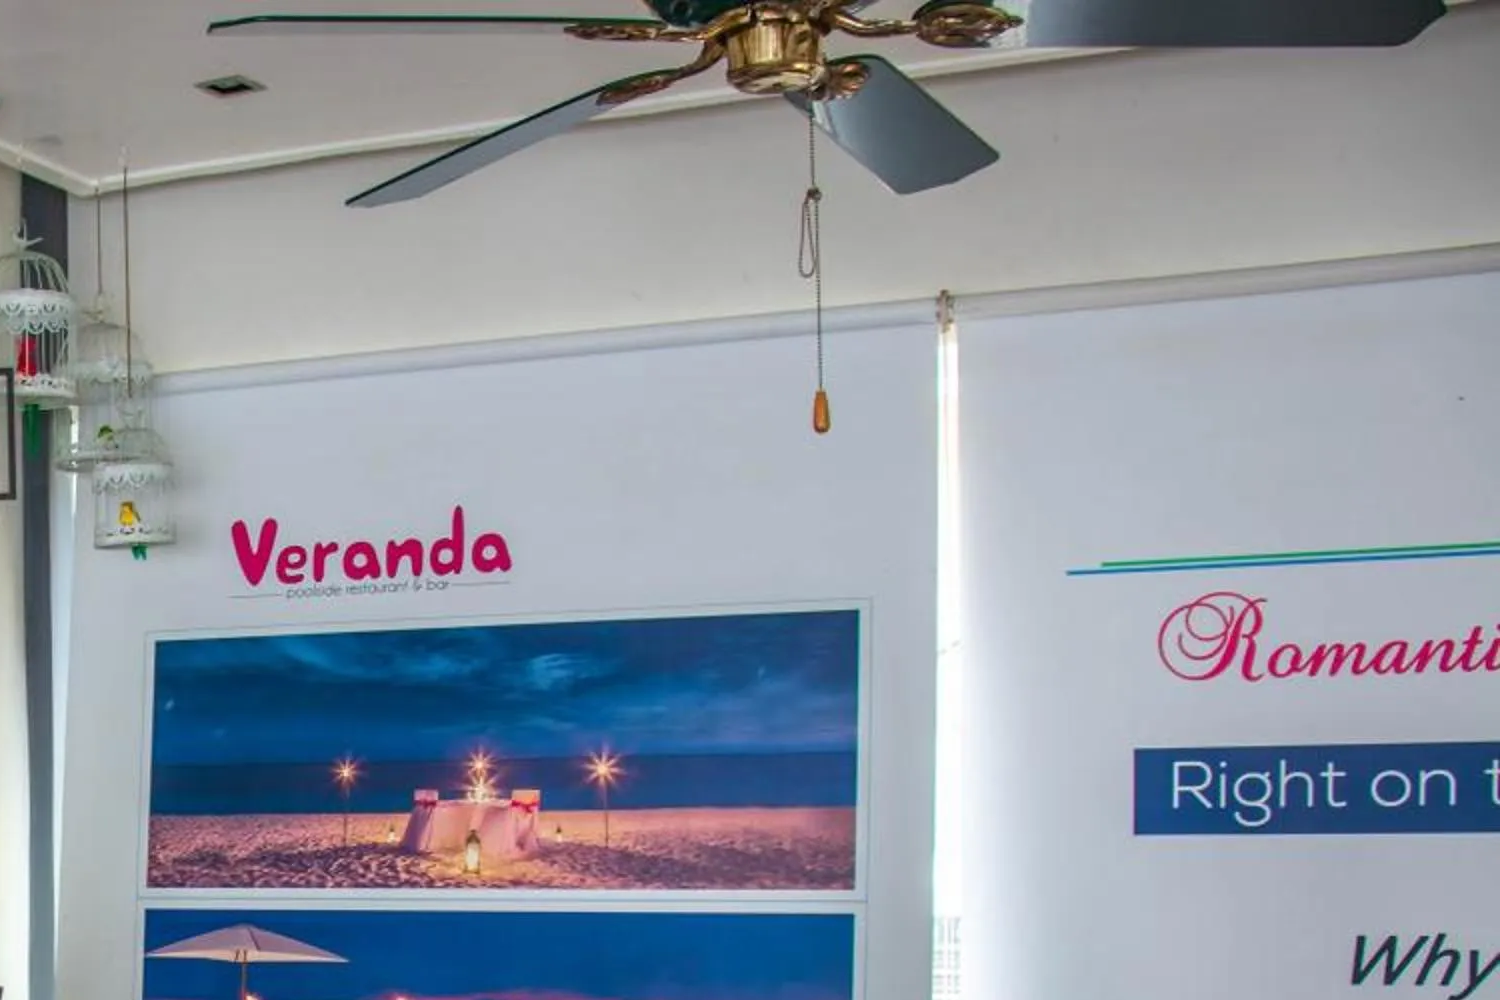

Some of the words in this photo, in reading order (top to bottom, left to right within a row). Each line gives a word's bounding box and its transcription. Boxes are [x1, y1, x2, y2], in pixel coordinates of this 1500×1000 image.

[231, 504, 513, 587] Veranda
[286, 583, 341, 599] poolside
[345, 581, 408, 595] restaurant
[425, 578, 450, 592] bar
[1172, 759, 1348, 827] Right
[1371, 769, 1456, 807] on
